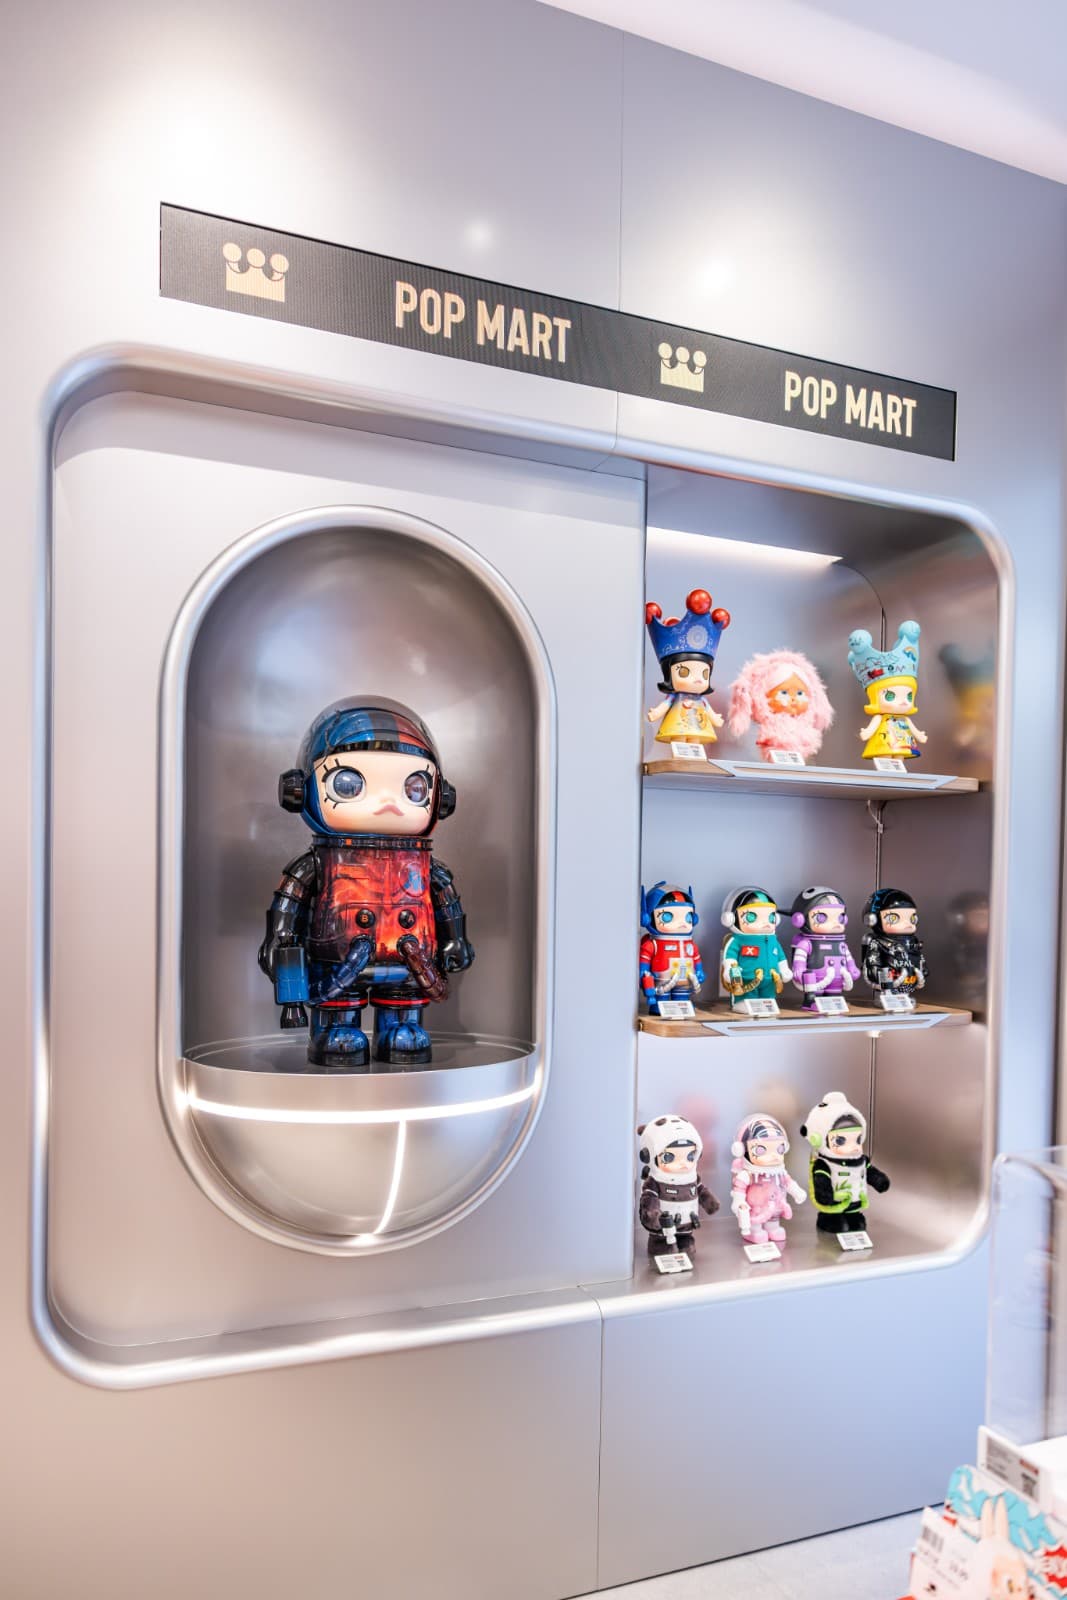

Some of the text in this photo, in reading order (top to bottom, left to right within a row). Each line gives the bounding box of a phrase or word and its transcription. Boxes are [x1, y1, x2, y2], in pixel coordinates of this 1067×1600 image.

[395, 281, 572, 363] POP MART
[784, 370, 918, 437] POP MART
[361, 914, 369, 923] B
